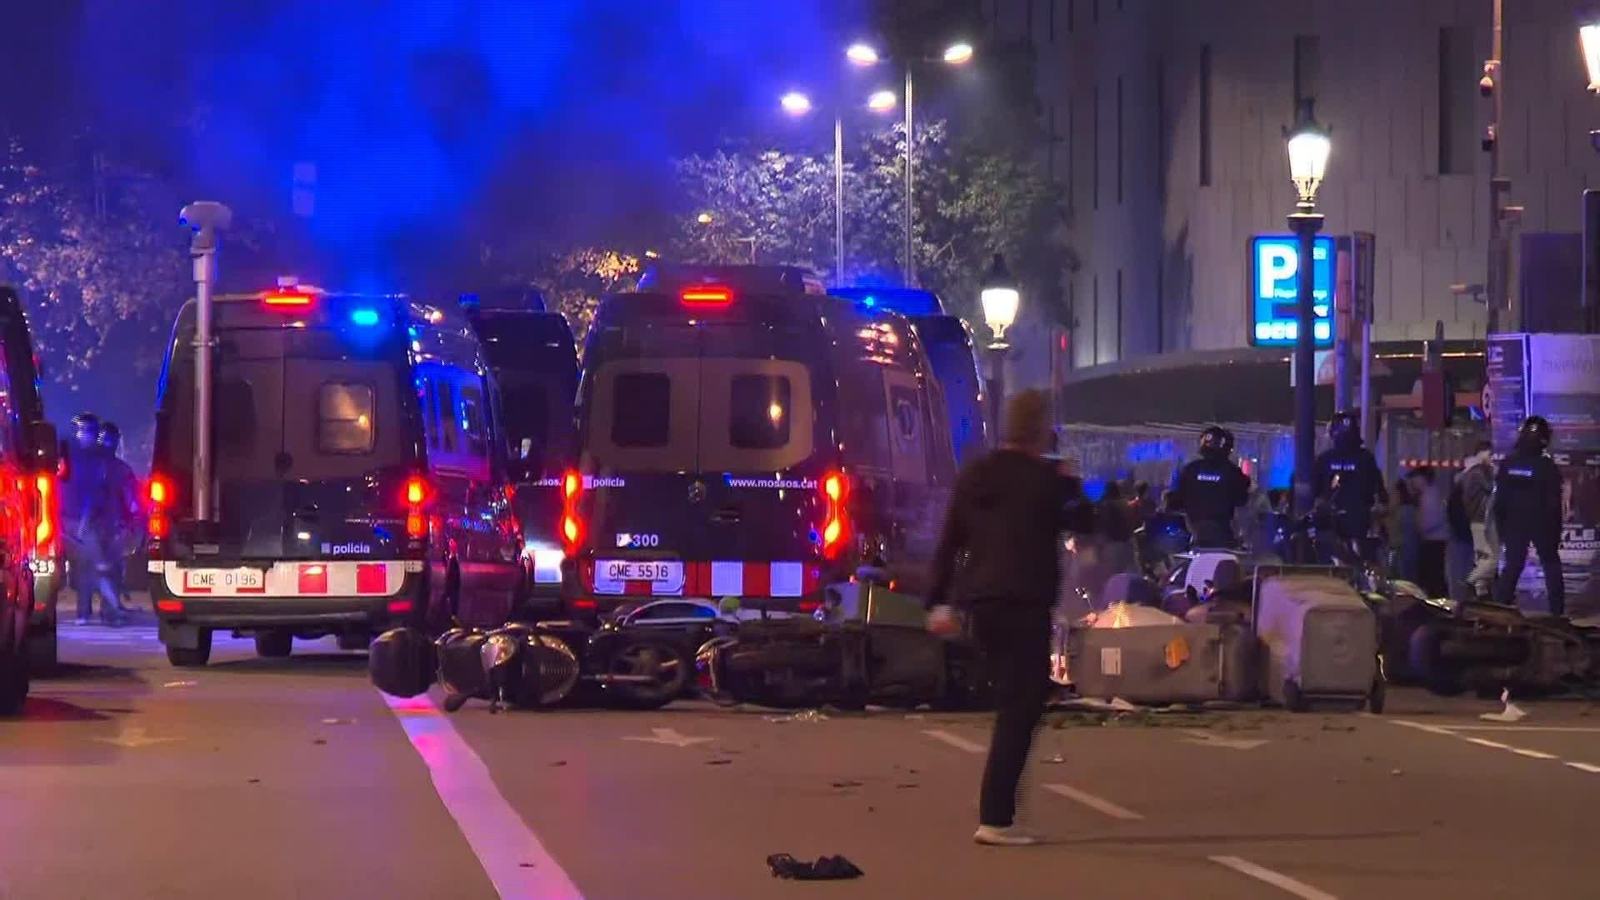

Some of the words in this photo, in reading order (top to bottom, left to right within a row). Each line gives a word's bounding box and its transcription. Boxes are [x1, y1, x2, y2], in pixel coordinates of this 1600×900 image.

[1260, 244, 1298, 298] P
[729, 479, 818, 489] www.mossos.cat
[608, 563, 632, 579] CME
[192, 573, 216, 586] CME
[225, 573, 257, 586] 0196
